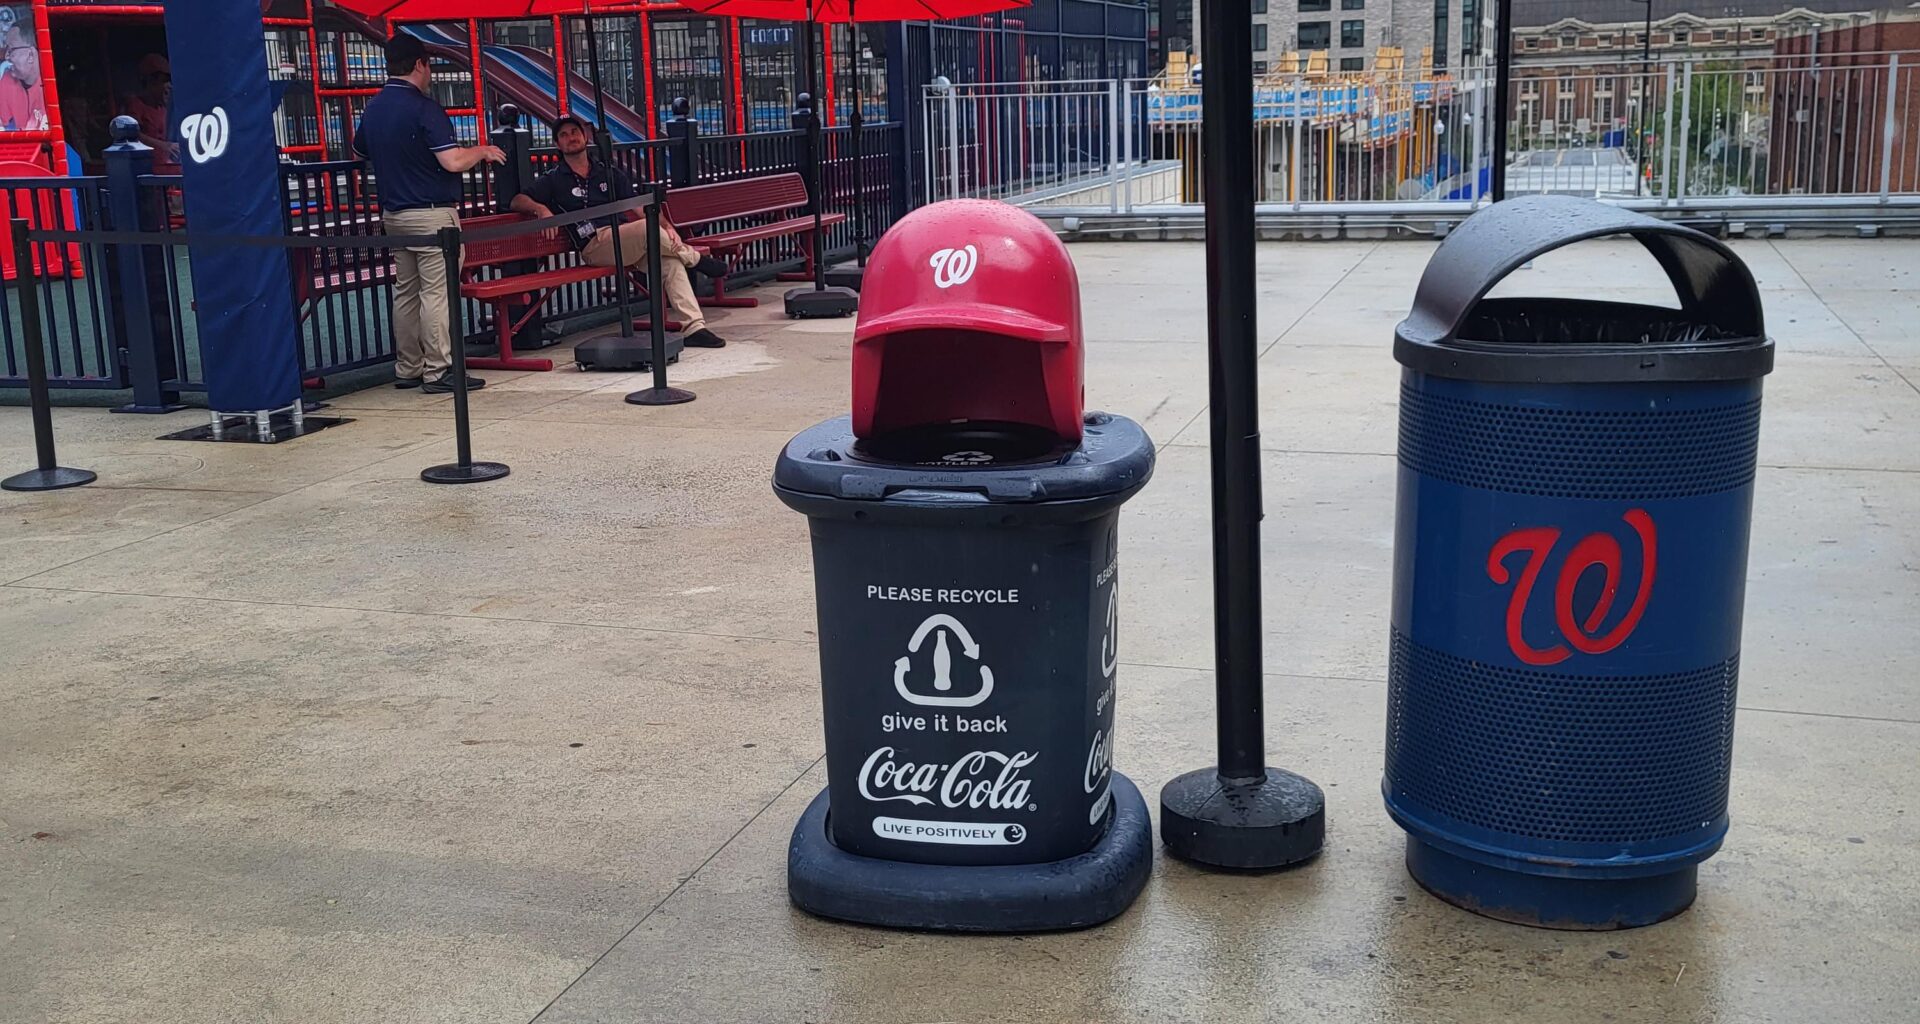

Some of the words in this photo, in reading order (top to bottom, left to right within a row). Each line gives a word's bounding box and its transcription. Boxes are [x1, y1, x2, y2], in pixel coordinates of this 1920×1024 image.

[181, 106, 228, 163] W
[930, 245, 977, 288] W
[867, 585, 933, 602] PLEASE
[937, 589, 1019, 603] RECYCLE
[1487, 508, 1657, 666] W
[882, 712, 926, 732] give
[934, 714, 949, 732] it
[956, 715, 1008, 733] back
[858, 746, 1039, 810] Coca-Cola
[883, 823, 912, 835] LIVE
[916, 826, 997, 839] POSITIVELY
